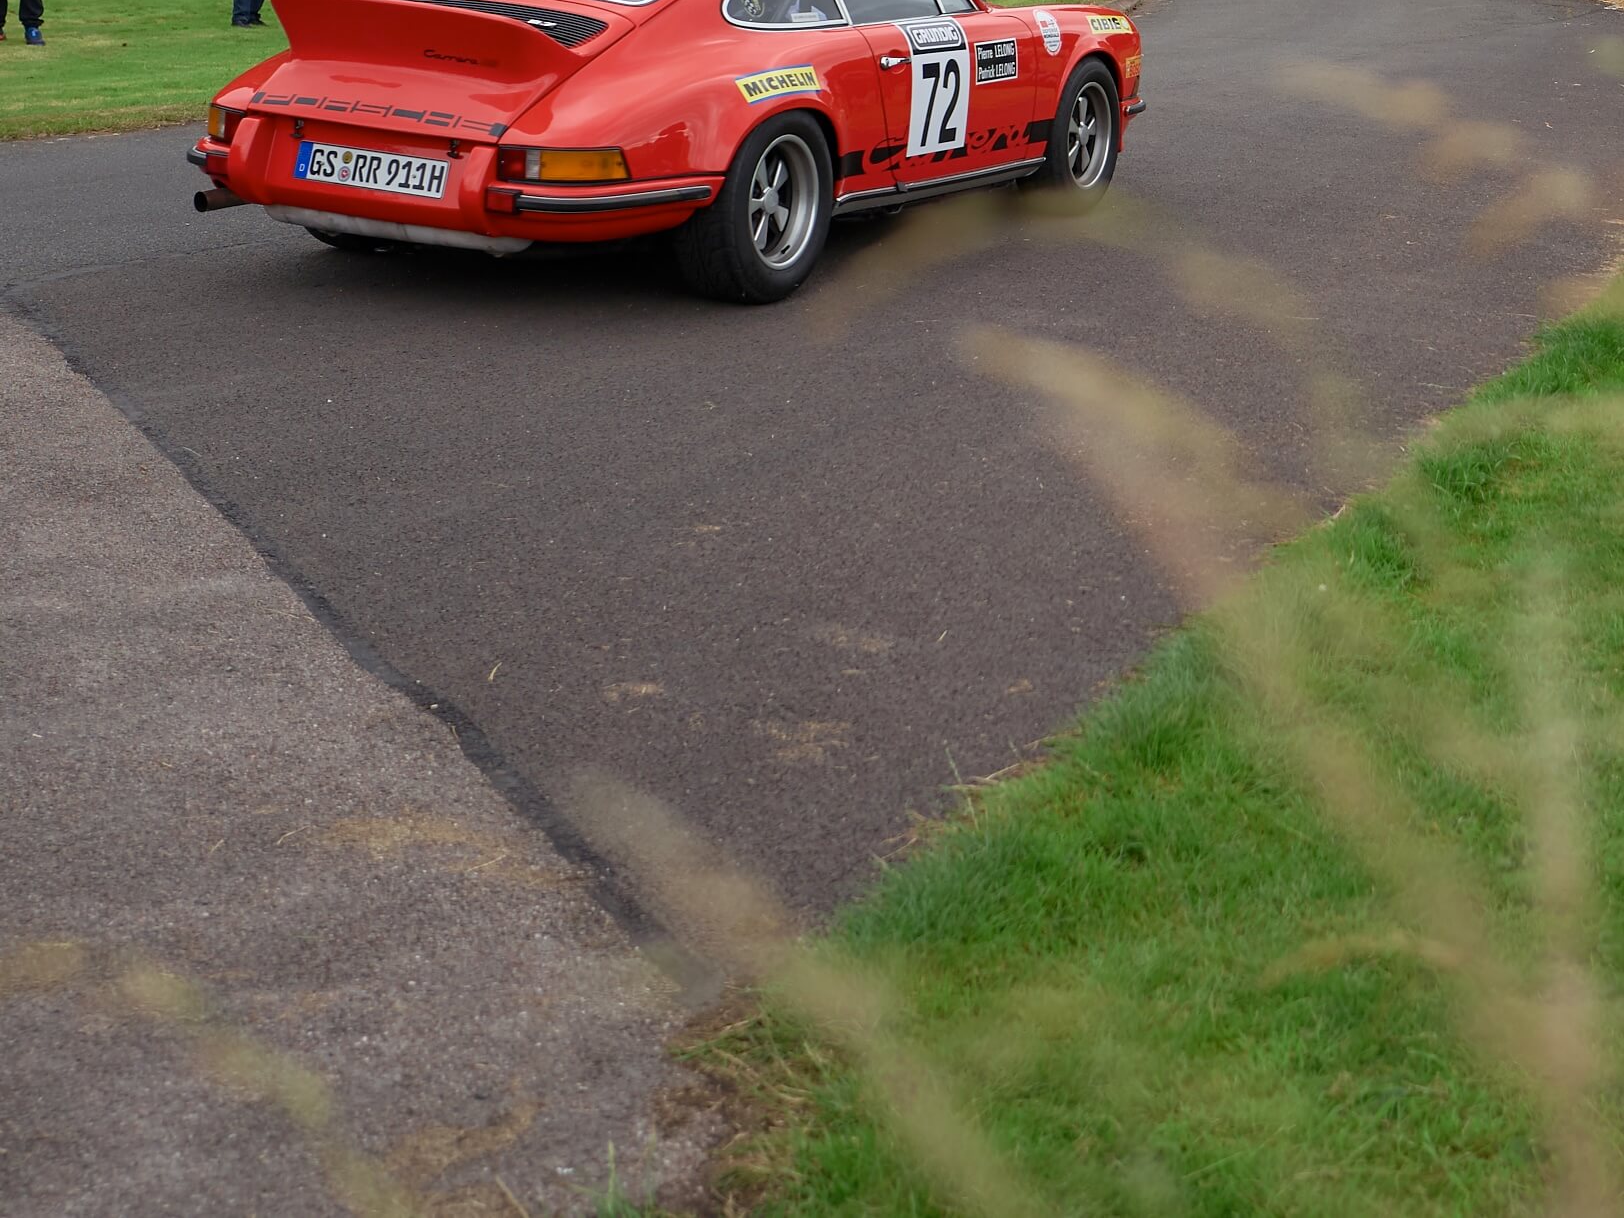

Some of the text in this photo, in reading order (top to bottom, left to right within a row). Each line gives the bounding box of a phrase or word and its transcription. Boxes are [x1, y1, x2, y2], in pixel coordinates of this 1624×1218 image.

[912, 26, 959, 44] GRUNDIG
[424, 49, 480, 65] Carrera
[994, 42, 1015, 58] LELONG
[996, 62, 1016, 77] LELONG
[743, 72, 817, 97] MICHELIN
[920, 58, 961, 147] 72
[309, 148, 446, 194] GS RR 911H
